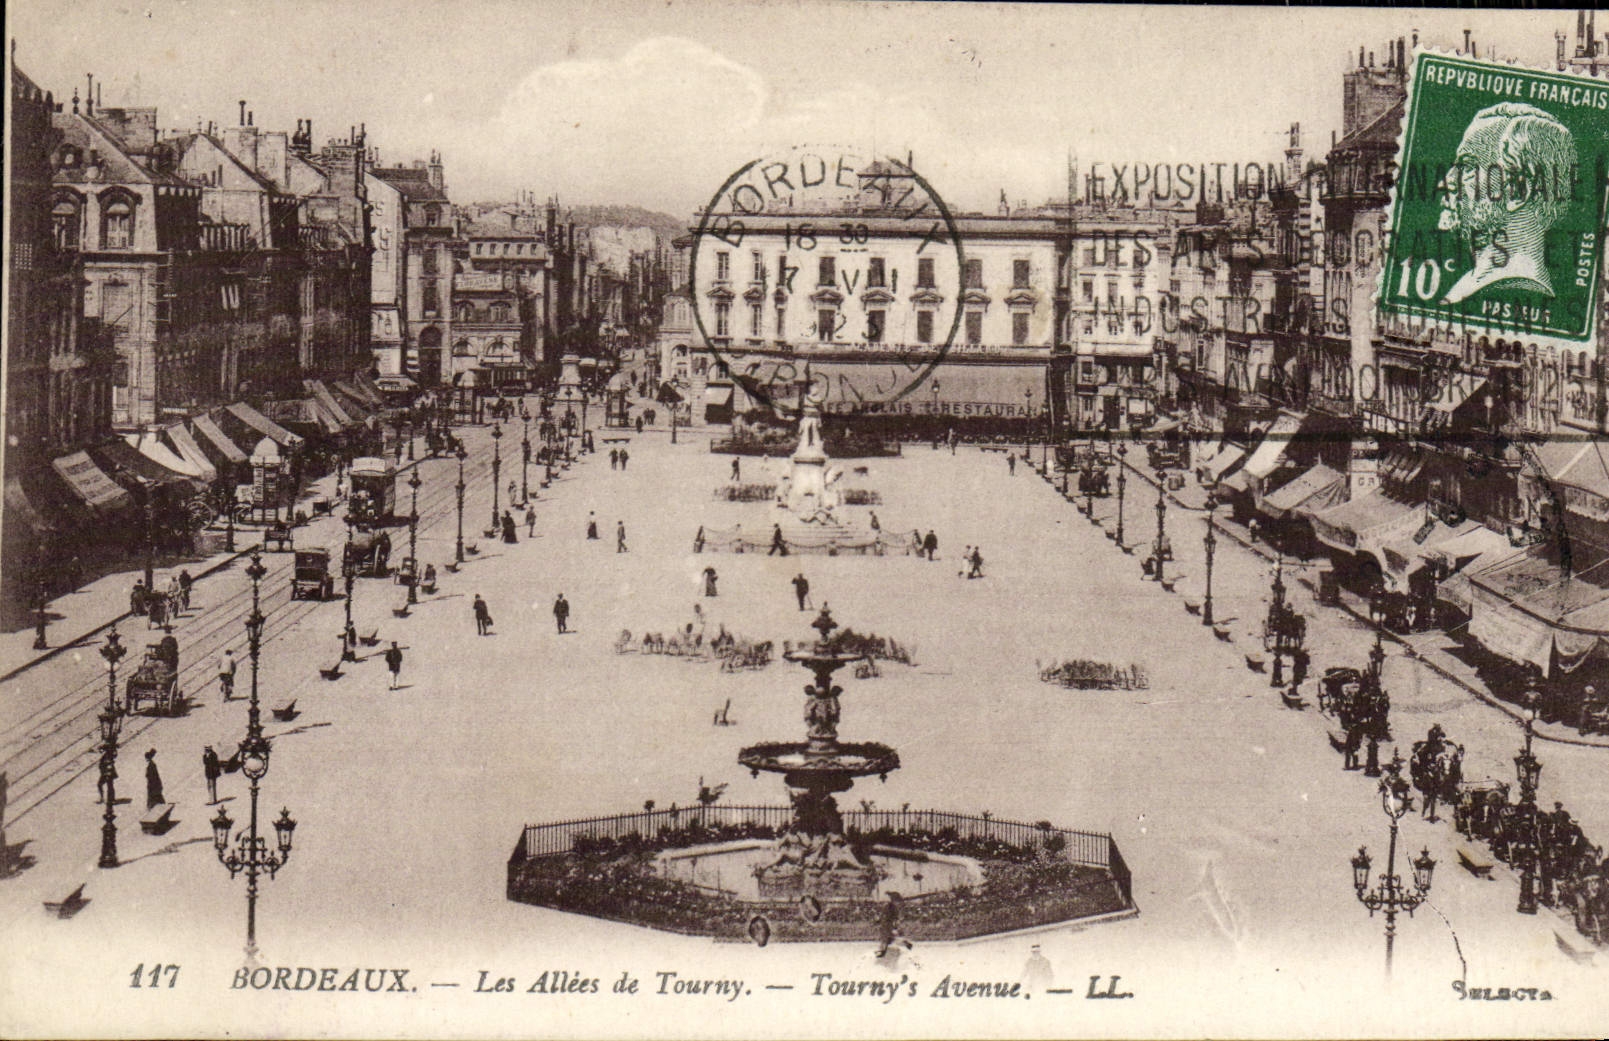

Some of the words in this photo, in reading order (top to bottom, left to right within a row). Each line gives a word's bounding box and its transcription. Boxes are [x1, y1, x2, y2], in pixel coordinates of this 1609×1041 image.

[1090, 163, 1285, 202] EXPOSITION
[1092, 229, 1152, 267] DES
[1575, 231, 1596, 287] POSTES
